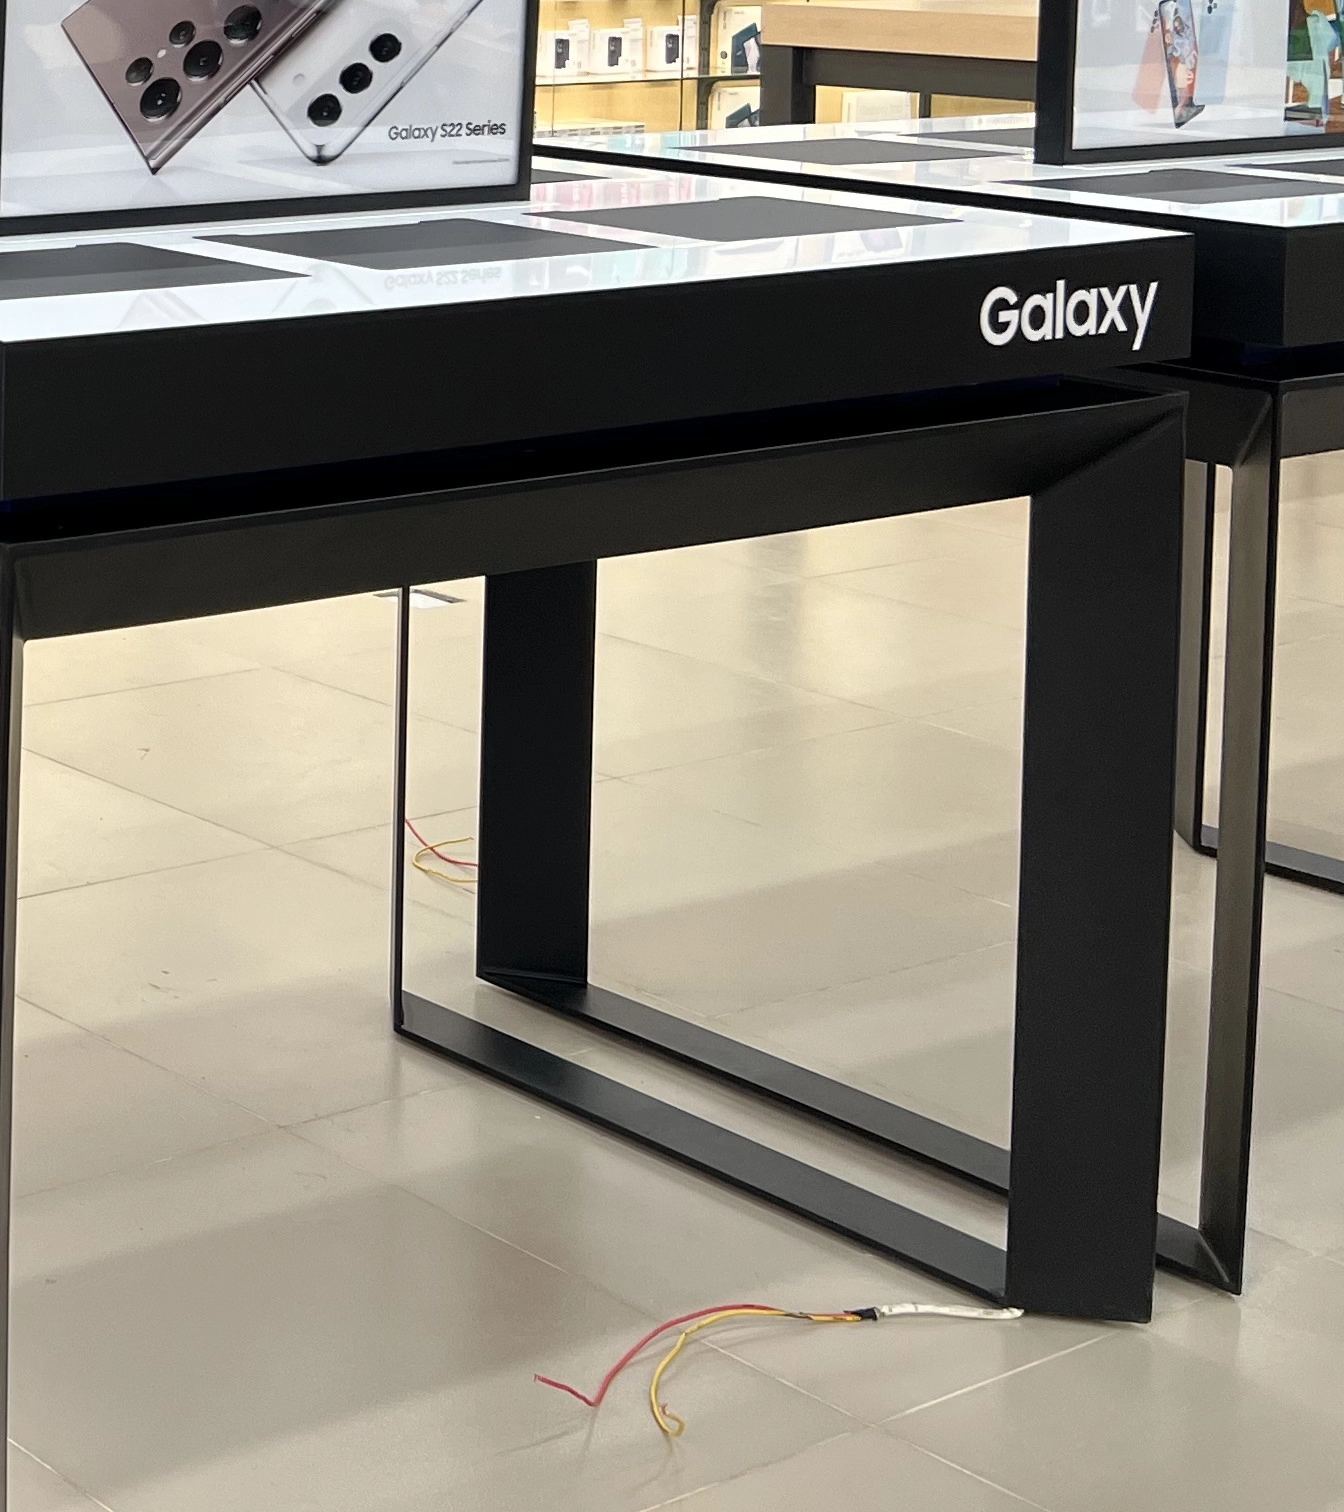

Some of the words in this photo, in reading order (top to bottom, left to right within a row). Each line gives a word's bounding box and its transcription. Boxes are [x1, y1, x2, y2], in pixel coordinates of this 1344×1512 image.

[388, 124, 439, 143] Galaxy
[440, 122, 463, 138] S22
[465, 119, 507, 137] Series
[979, 279, 1159, 352] Galaxy
